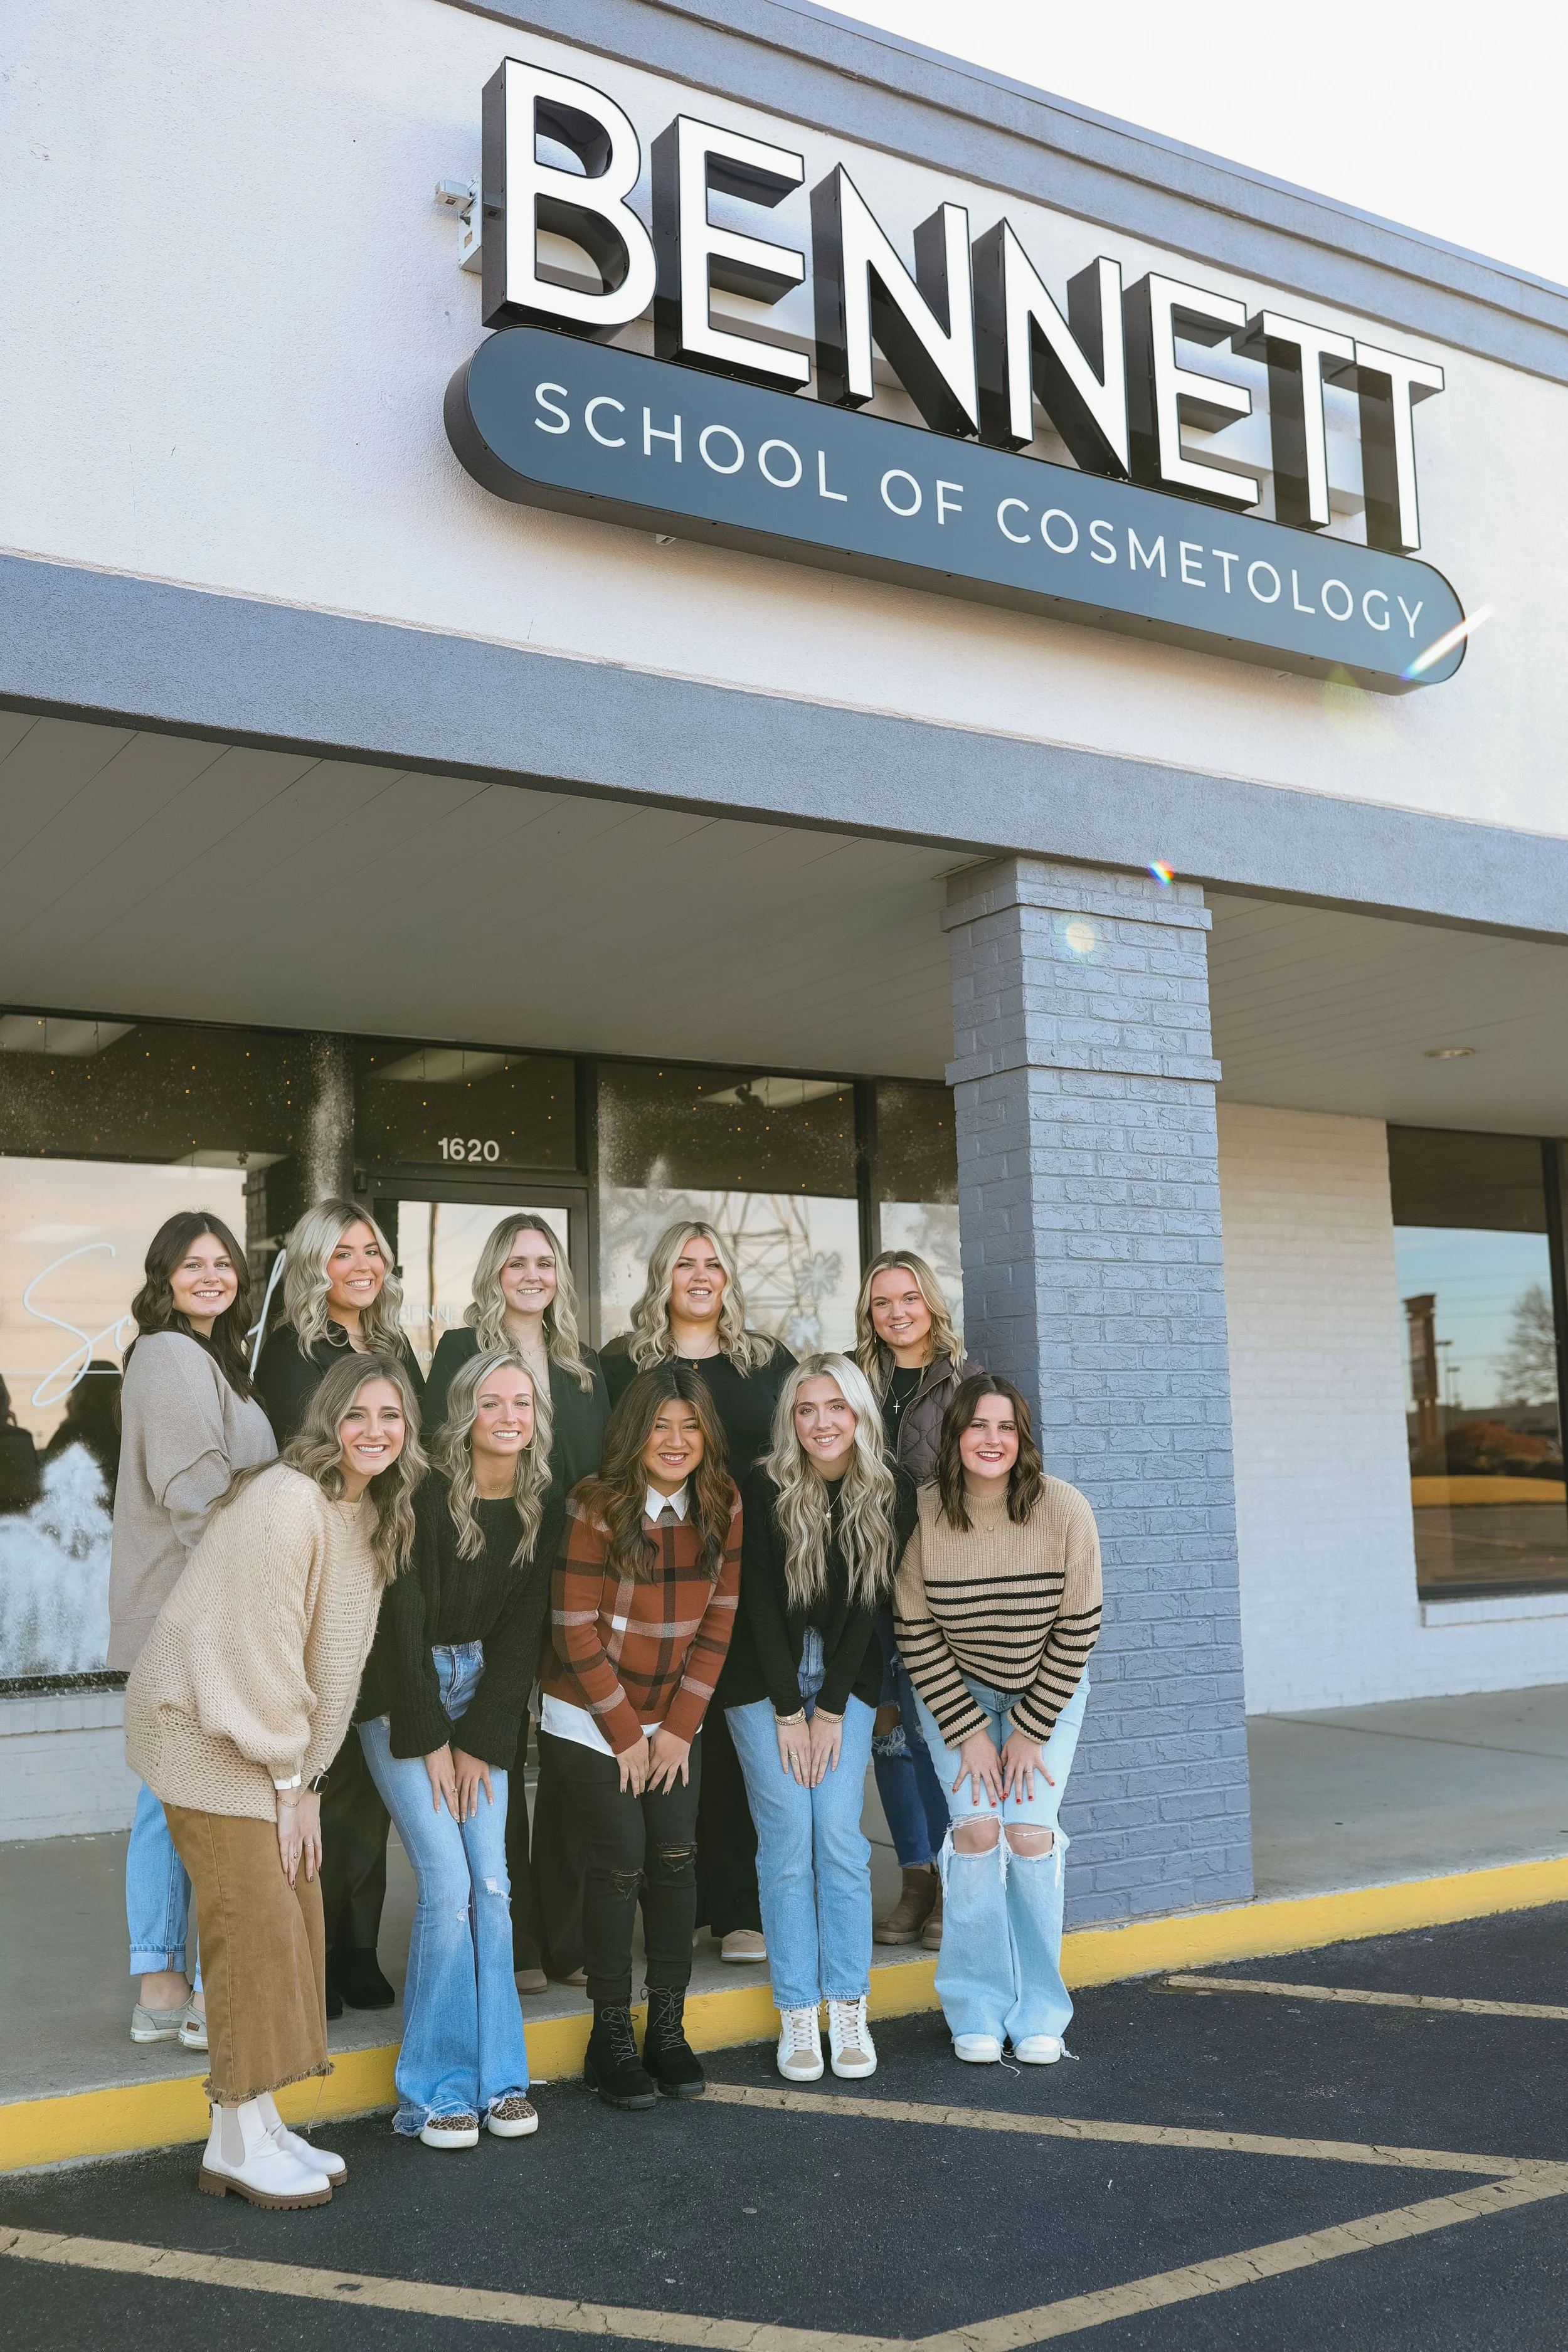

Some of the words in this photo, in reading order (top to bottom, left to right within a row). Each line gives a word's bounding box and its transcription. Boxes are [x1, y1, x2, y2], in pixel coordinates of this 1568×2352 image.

[504, 56, 1445, 552] BENNETT
[534, 381, 849, 504] SCHOOL
[880, 469, 965, 526] OF
[996, 497, 1424, 639] COSMETOLOGY
[438, 1137, 500, 1162] 1620
